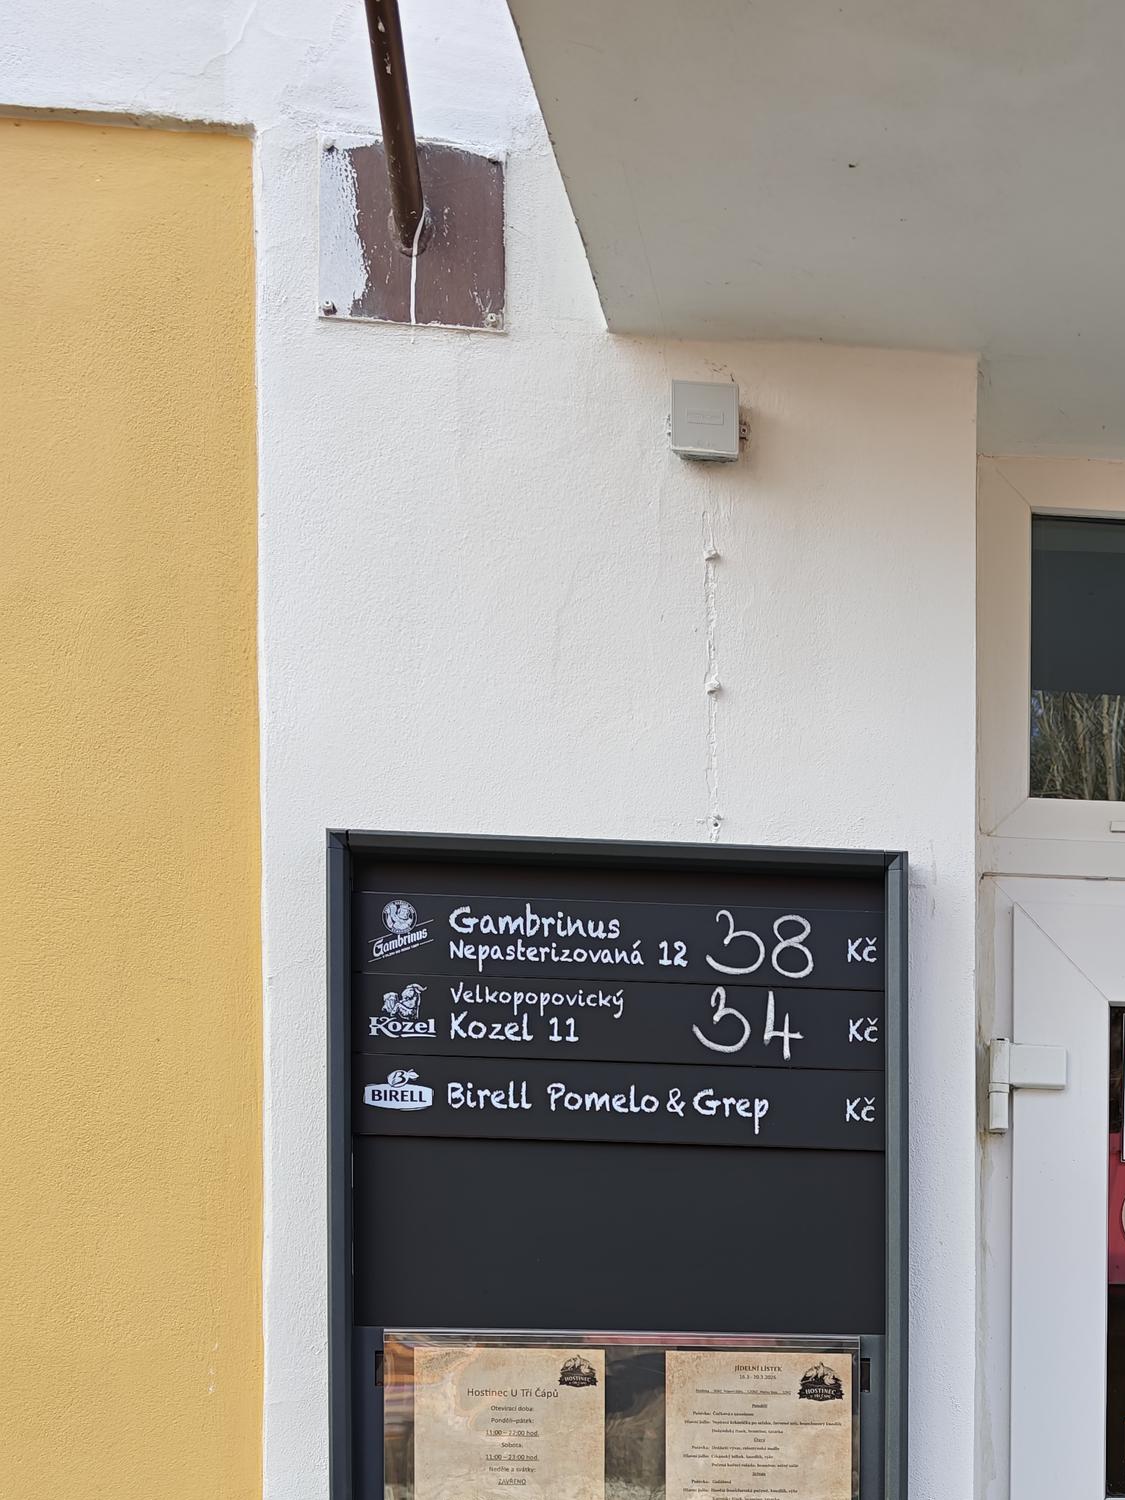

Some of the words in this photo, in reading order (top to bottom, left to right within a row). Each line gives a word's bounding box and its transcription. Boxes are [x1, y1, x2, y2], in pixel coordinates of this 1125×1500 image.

[449, 903, 620, 939] Gambrinus
[373, 928, 428, 957] Gambrinus
[449, 939, 645, 972] Nepasterizovaná
[658, 940, 688, 967] 12
[705, 909, 814, 979] 38
[847, 937, 877, 963] Kč
[450, 982, 625, 1018] Velkopopovický
[369, 1016, 437, 1038] Kozel
[449, 1011, 533, 1042] Kozel
[549, 1017, 579, 1043] 11
[692, 985, 805, 1061] 34
[849, 1017, 878, 1043] Kč
[371, 1089, 427, 1103] BIRELL
[447, 1081, 532, 1110] Birell
[846, 1097, 876, 1122] Kč
[734, 1364, 760, 1372] JÍDELNÍ
[760, 1364, 783, 1372] LÍSTEK
[467, 1388, 508, 1398] Hostinec
[511, 1389, 518, 1398] U
[535, 1387, 559, 1399] Čápů
[805, 1387, 837, 1395] HOSTINEC
